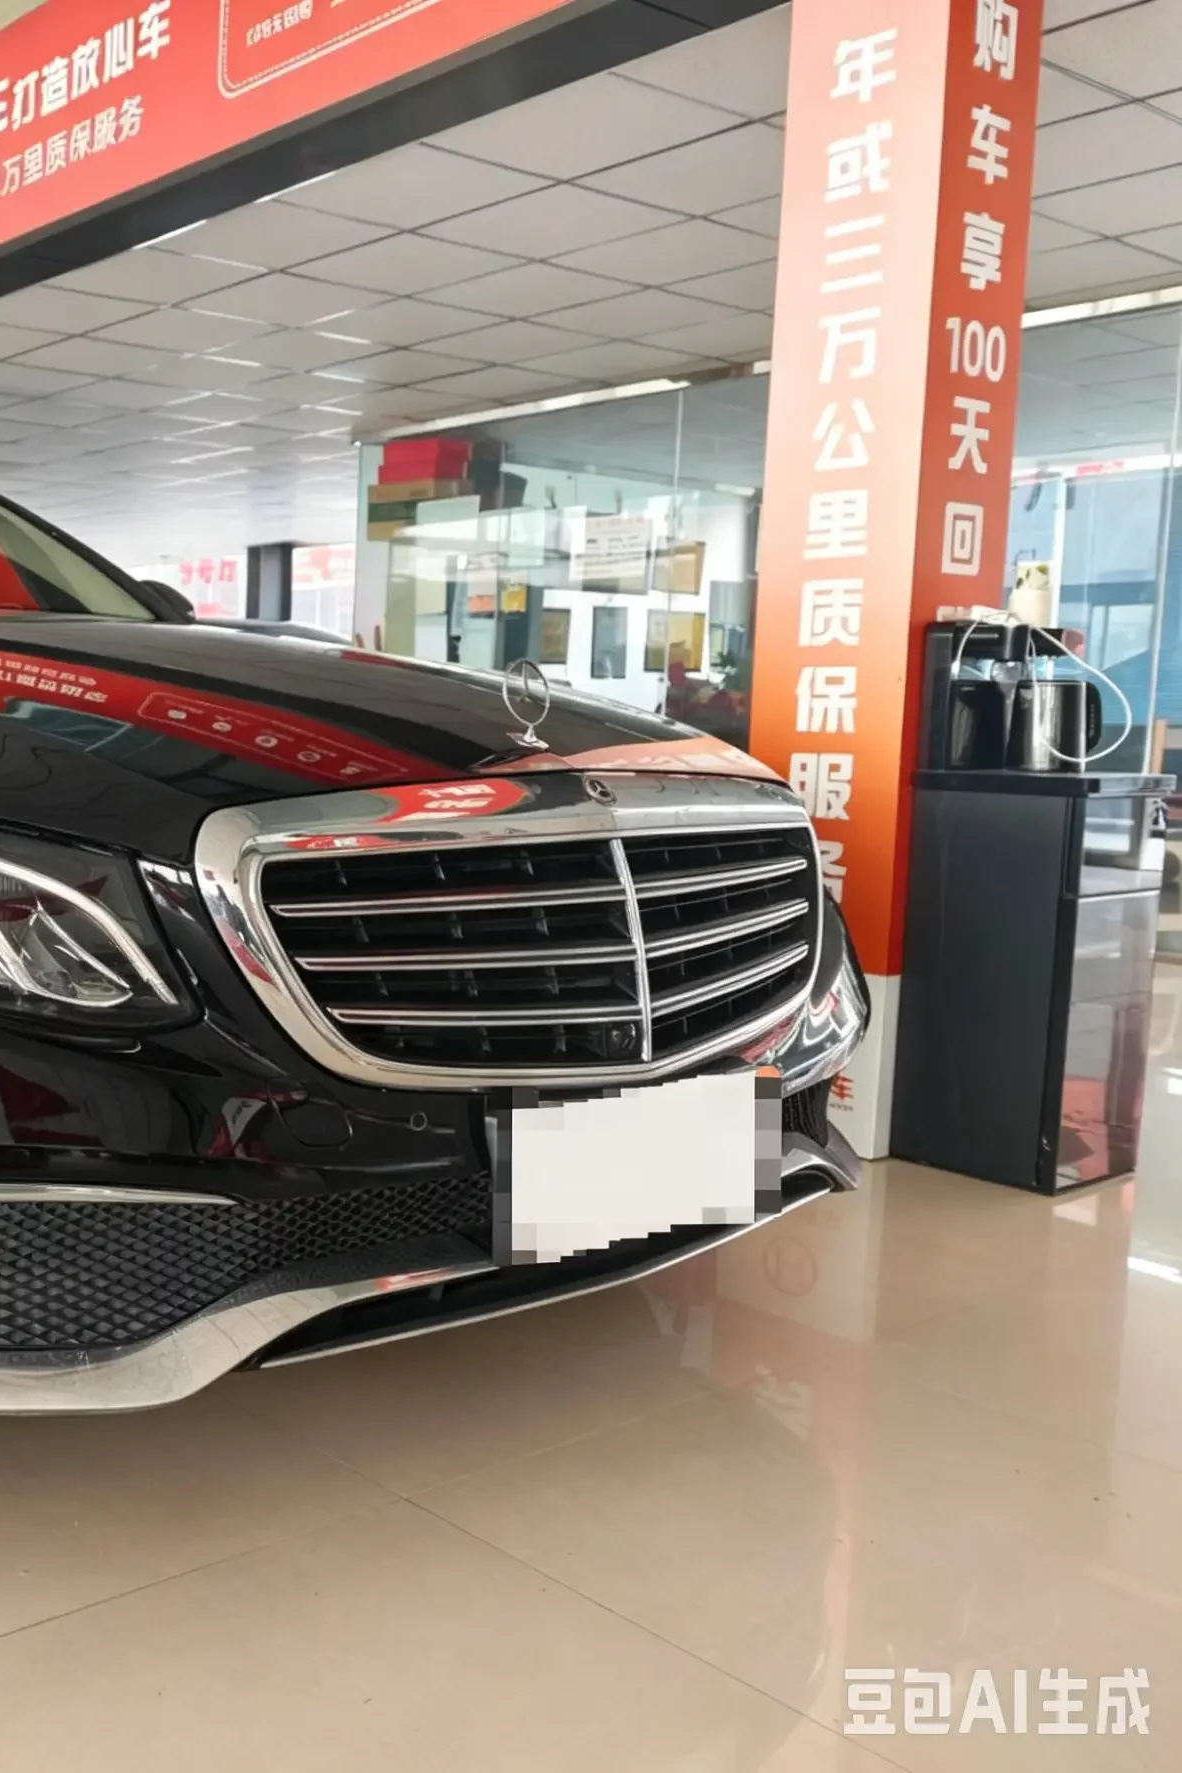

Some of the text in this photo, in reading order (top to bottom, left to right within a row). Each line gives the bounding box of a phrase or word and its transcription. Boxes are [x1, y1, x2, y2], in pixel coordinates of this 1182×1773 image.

[936, 0, 1018, 622] 购车享100天回
